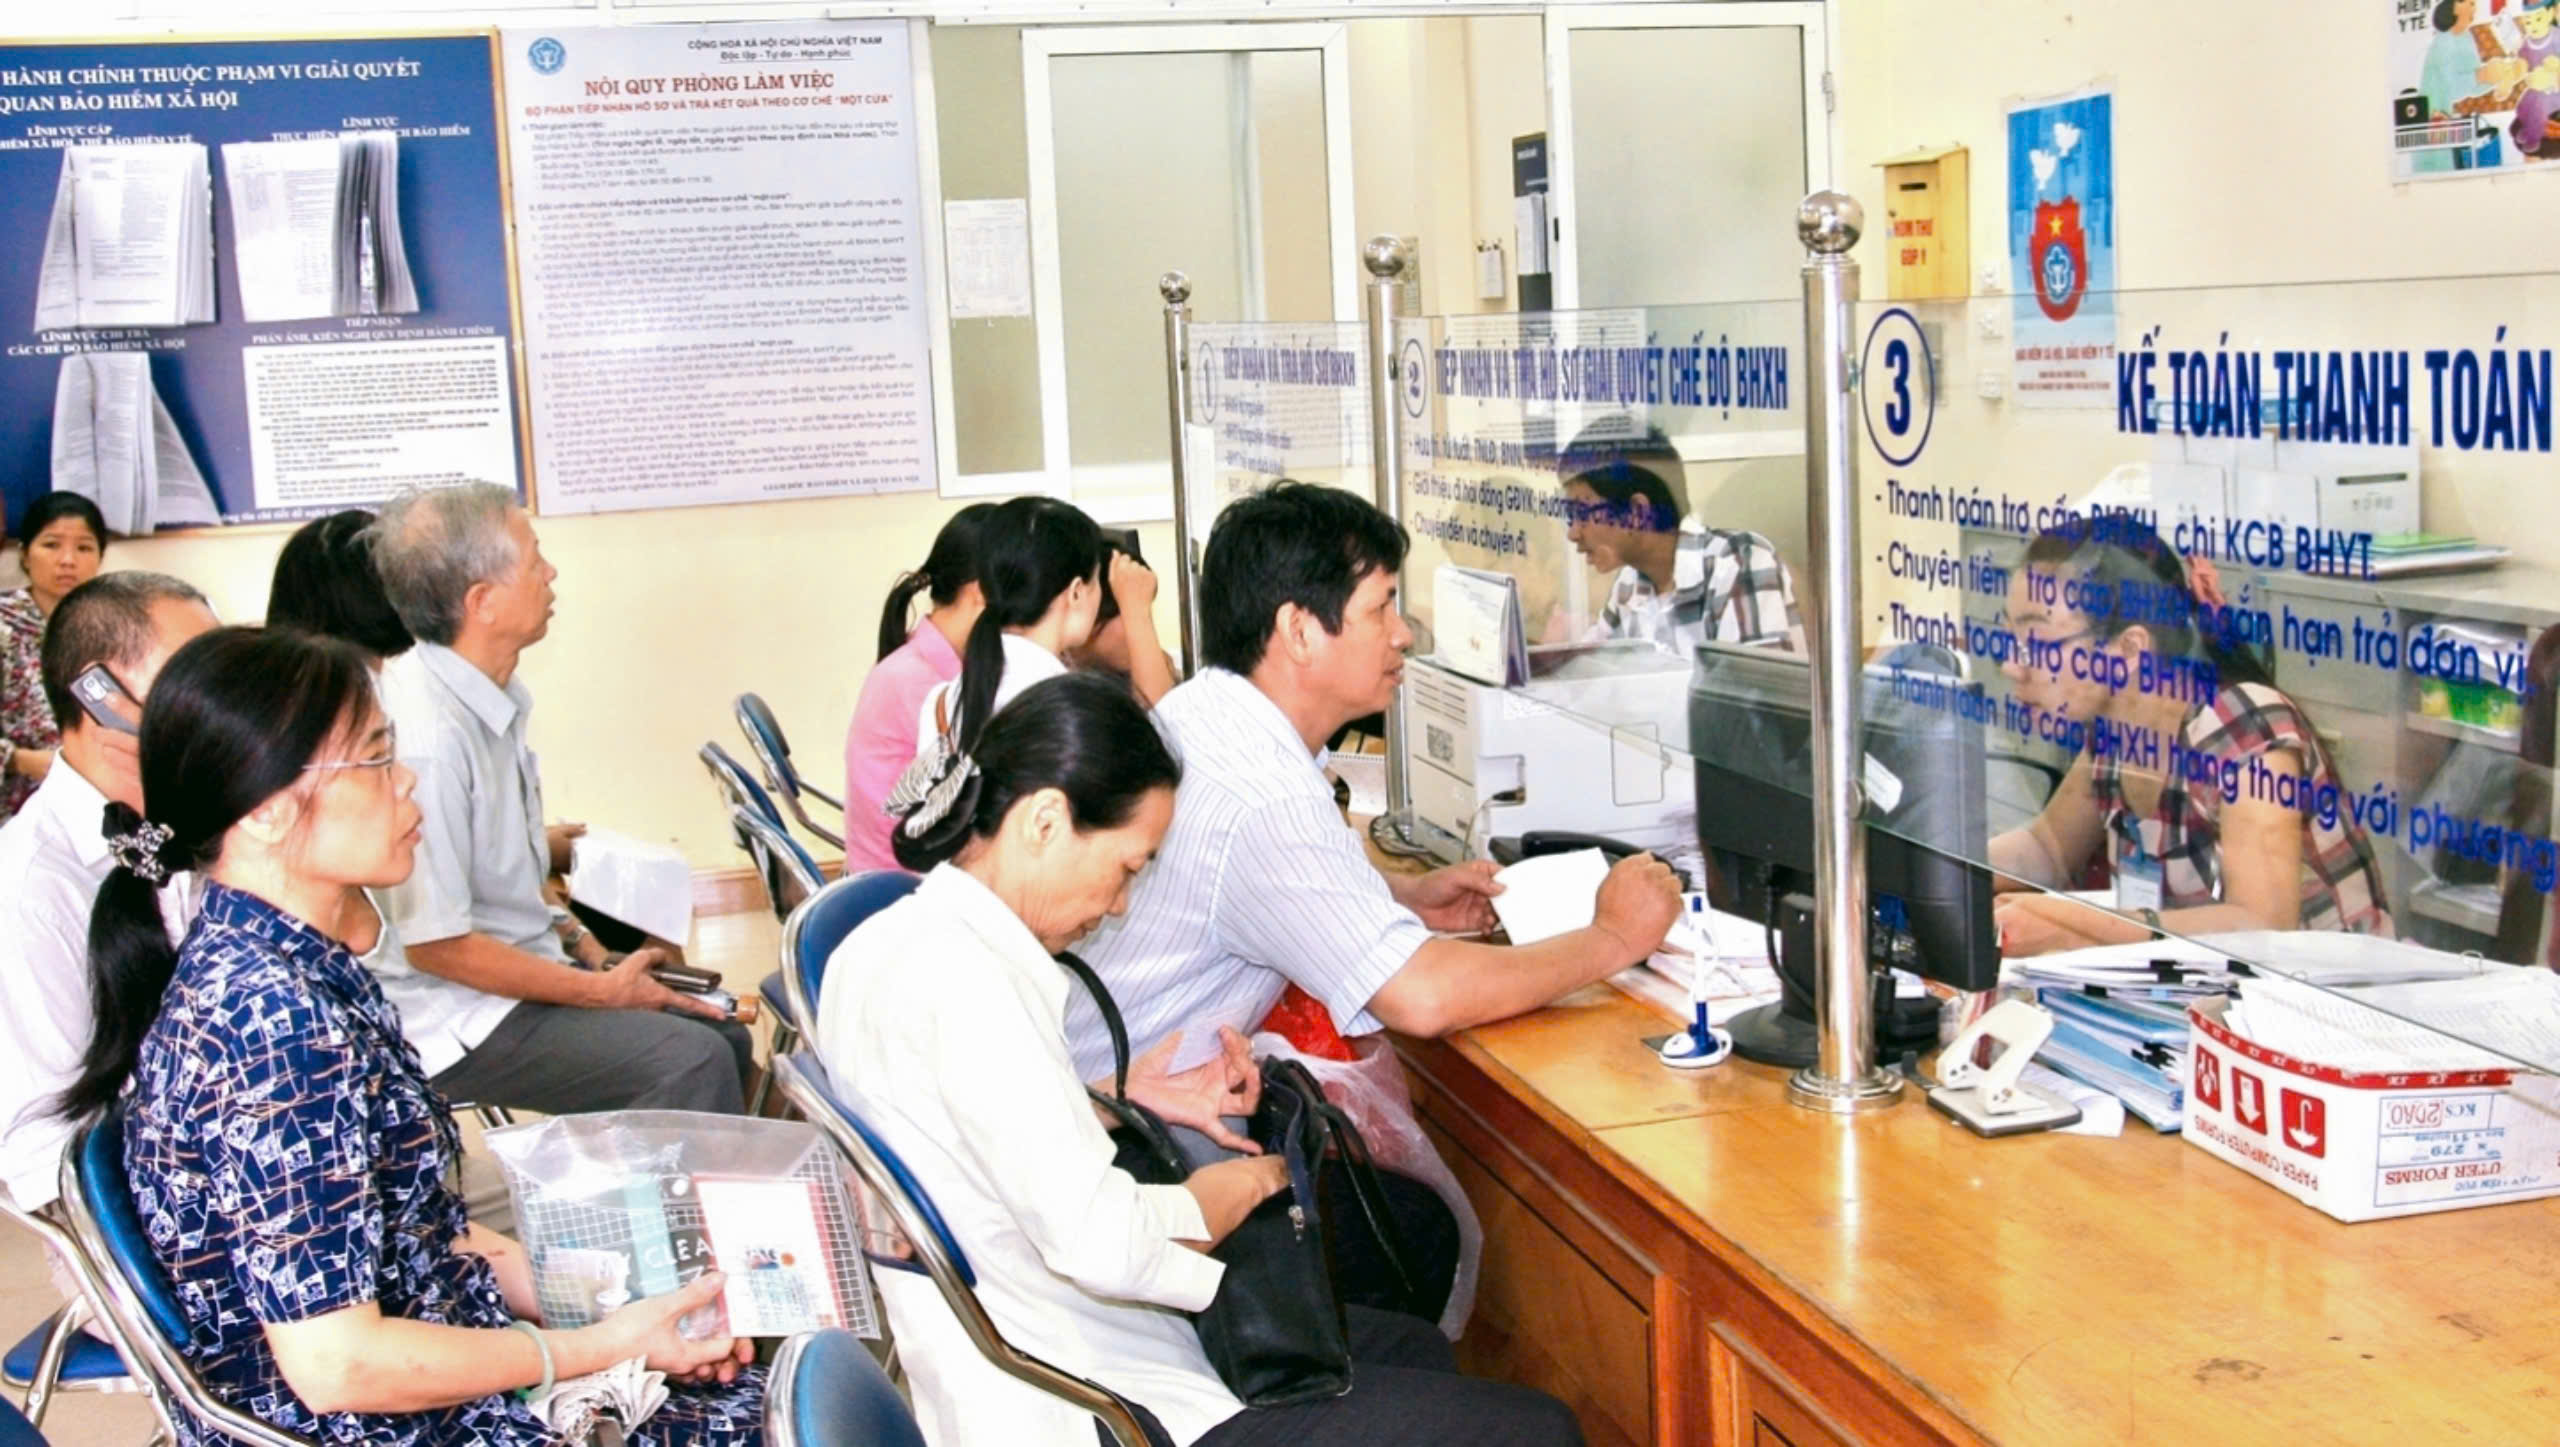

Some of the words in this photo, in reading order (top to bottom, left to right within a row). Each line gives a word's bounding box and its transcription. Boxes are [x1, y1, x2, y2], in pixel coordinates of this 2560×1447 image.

[3, 66, 63, 86] HÀNH
[67, 63, 136, 84] CHÍNH
[138, 63, 212, 87] THUỘC
[216, 65, 276, 84] PHẠM
[278, 64, 302, 79] VI
[305, 59, 350, 79] GIẢI
[353, 56, 422, 80] QUYẾT
[688, 40, 717, 50] CỘNG
[860, 36, 882, 45] NAM
[0, 96, 55, 114] QUAN
[59, 89, 104, 110] BẢO
[107, 88, 163, 109] HIỂM
[167, 88, 197, 108] XÃ
[200, 88, 239, 111] HỘI
[584, 76, 620, 99] NỘI
[624, 78, 666, 95] QUY
[672, 71, 739, 93] PHÒNG
[744, 71, 785, 91] LÀM
[790, 69, 834, 91] VIỆC
[762, 96, 790, 107] THEO
[1616, 330, 1664, 409] QUYẾT
[1669, 330, 1703, 407] CHẾ
[1706, 333, 1731, 420] ĐỘ
[1736, 346, 1789, 410] BHXH
[1884, 338, 1911, 438] 3
[2117, 324, 2161, 434] KẾ
[2168, 331, 2261, 439] TOÁN
[2273, 350, 2409, 446] THANH
[2424, 325, 2552, 453] TOÁN
[1887, 479, 1943, 522] Thanh
[1949, 486, 1996, 531] toán
[2002, 493, 2030, 544] trợ
[2036, 493, 2084, 548] cấp
[2174, 514, 2216, 560] chi
[2225, 517, 2285, 568] KCB
[1969, 550, 2008, 597] tiền
[2027, 564, 2057, 616] trợ
[2282, 604, 2343, 667] hạn
[2353, 611, 2398, 670] trả
[2409, 624, 2480, 683] đơn
[1890, 602, 1958, 652] Thanh
[1963, 614, 2019, 666] toán
[2026, 628, 2063, 683] trợ
[2070, 640, 2129, 697] cấp
[1890, 662, 1946, 713] Thanh
[2005, 692, 2032, 745] trợ
[2038, 702, 2087, 754] cấp
[2093, 715, 2160, 771] BHXH
[2350, 781, 2397, 838] với
[2446, 1103, 2477, 1118] KCS
[2384, 1166, 2449, 1186] FORMS
